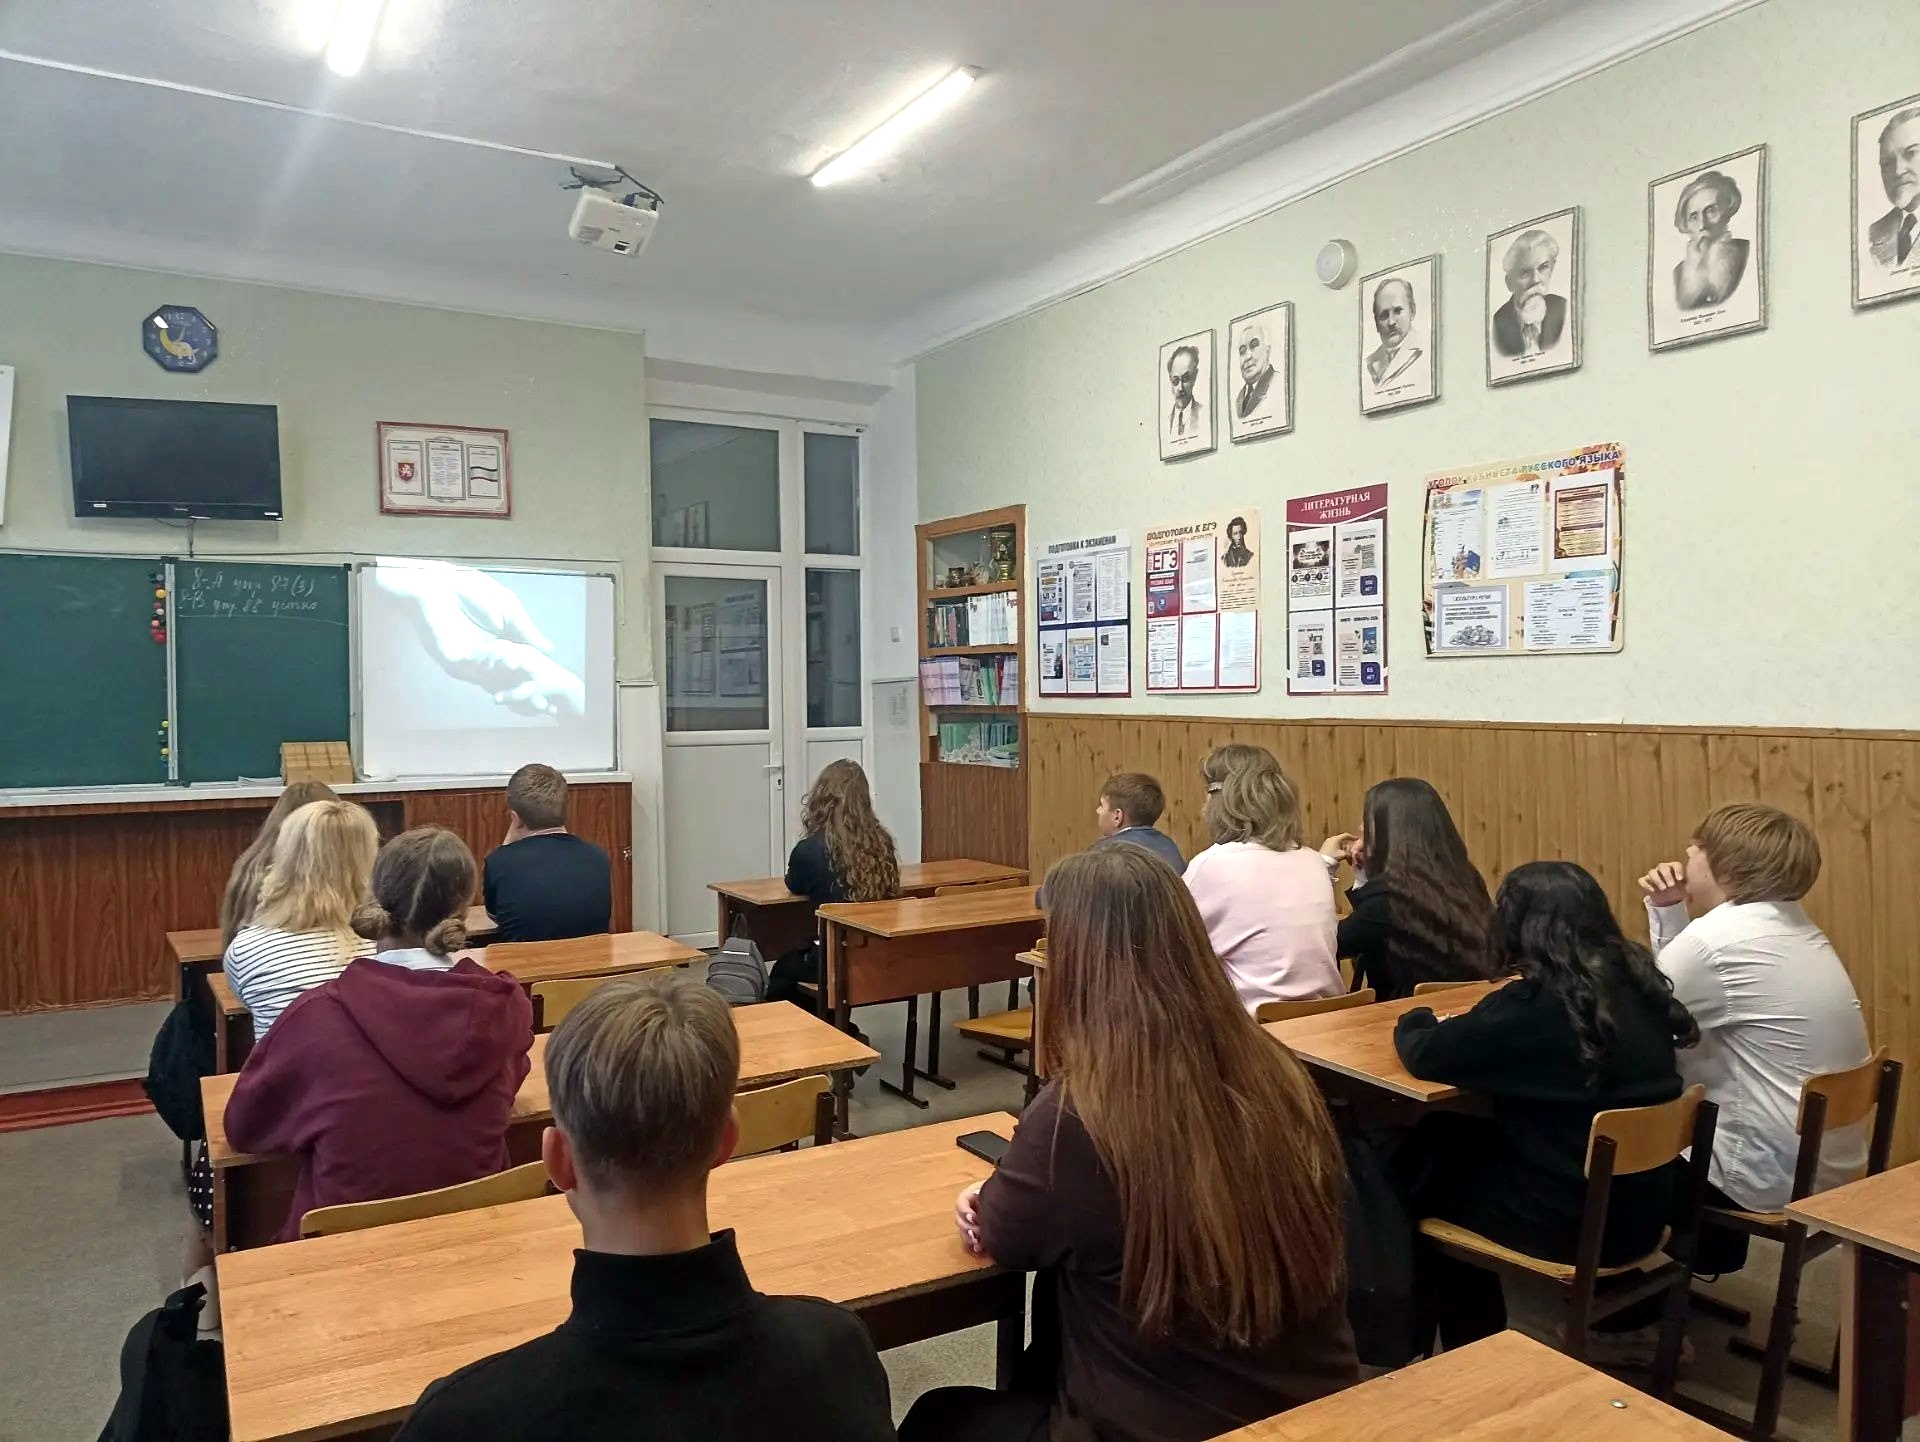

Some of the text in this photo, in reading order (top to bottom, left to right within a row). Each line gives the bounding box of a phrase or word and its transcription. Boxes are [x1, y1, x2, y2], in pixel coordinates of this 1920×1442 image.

[1428, 475, 1464, 490] УГОЛОК
[1521, 458, 1576, 474] РУССКОГО
[1579, 450, 1619, 465] ЯЗЫКА
[1301, 491, 1371, 512] ЛИТЕРАТУРНАЯ
[1319, 506, 1352, 520] ЖИЗНЬ
[1146, 526, 1193, 541] ПОДГОТОВКА
[1194, 524, 1201, 533] К
[1202, 521, 1217, 532] ЕГЭ
[1153, 549, 1178, 571] ЕГЭ
